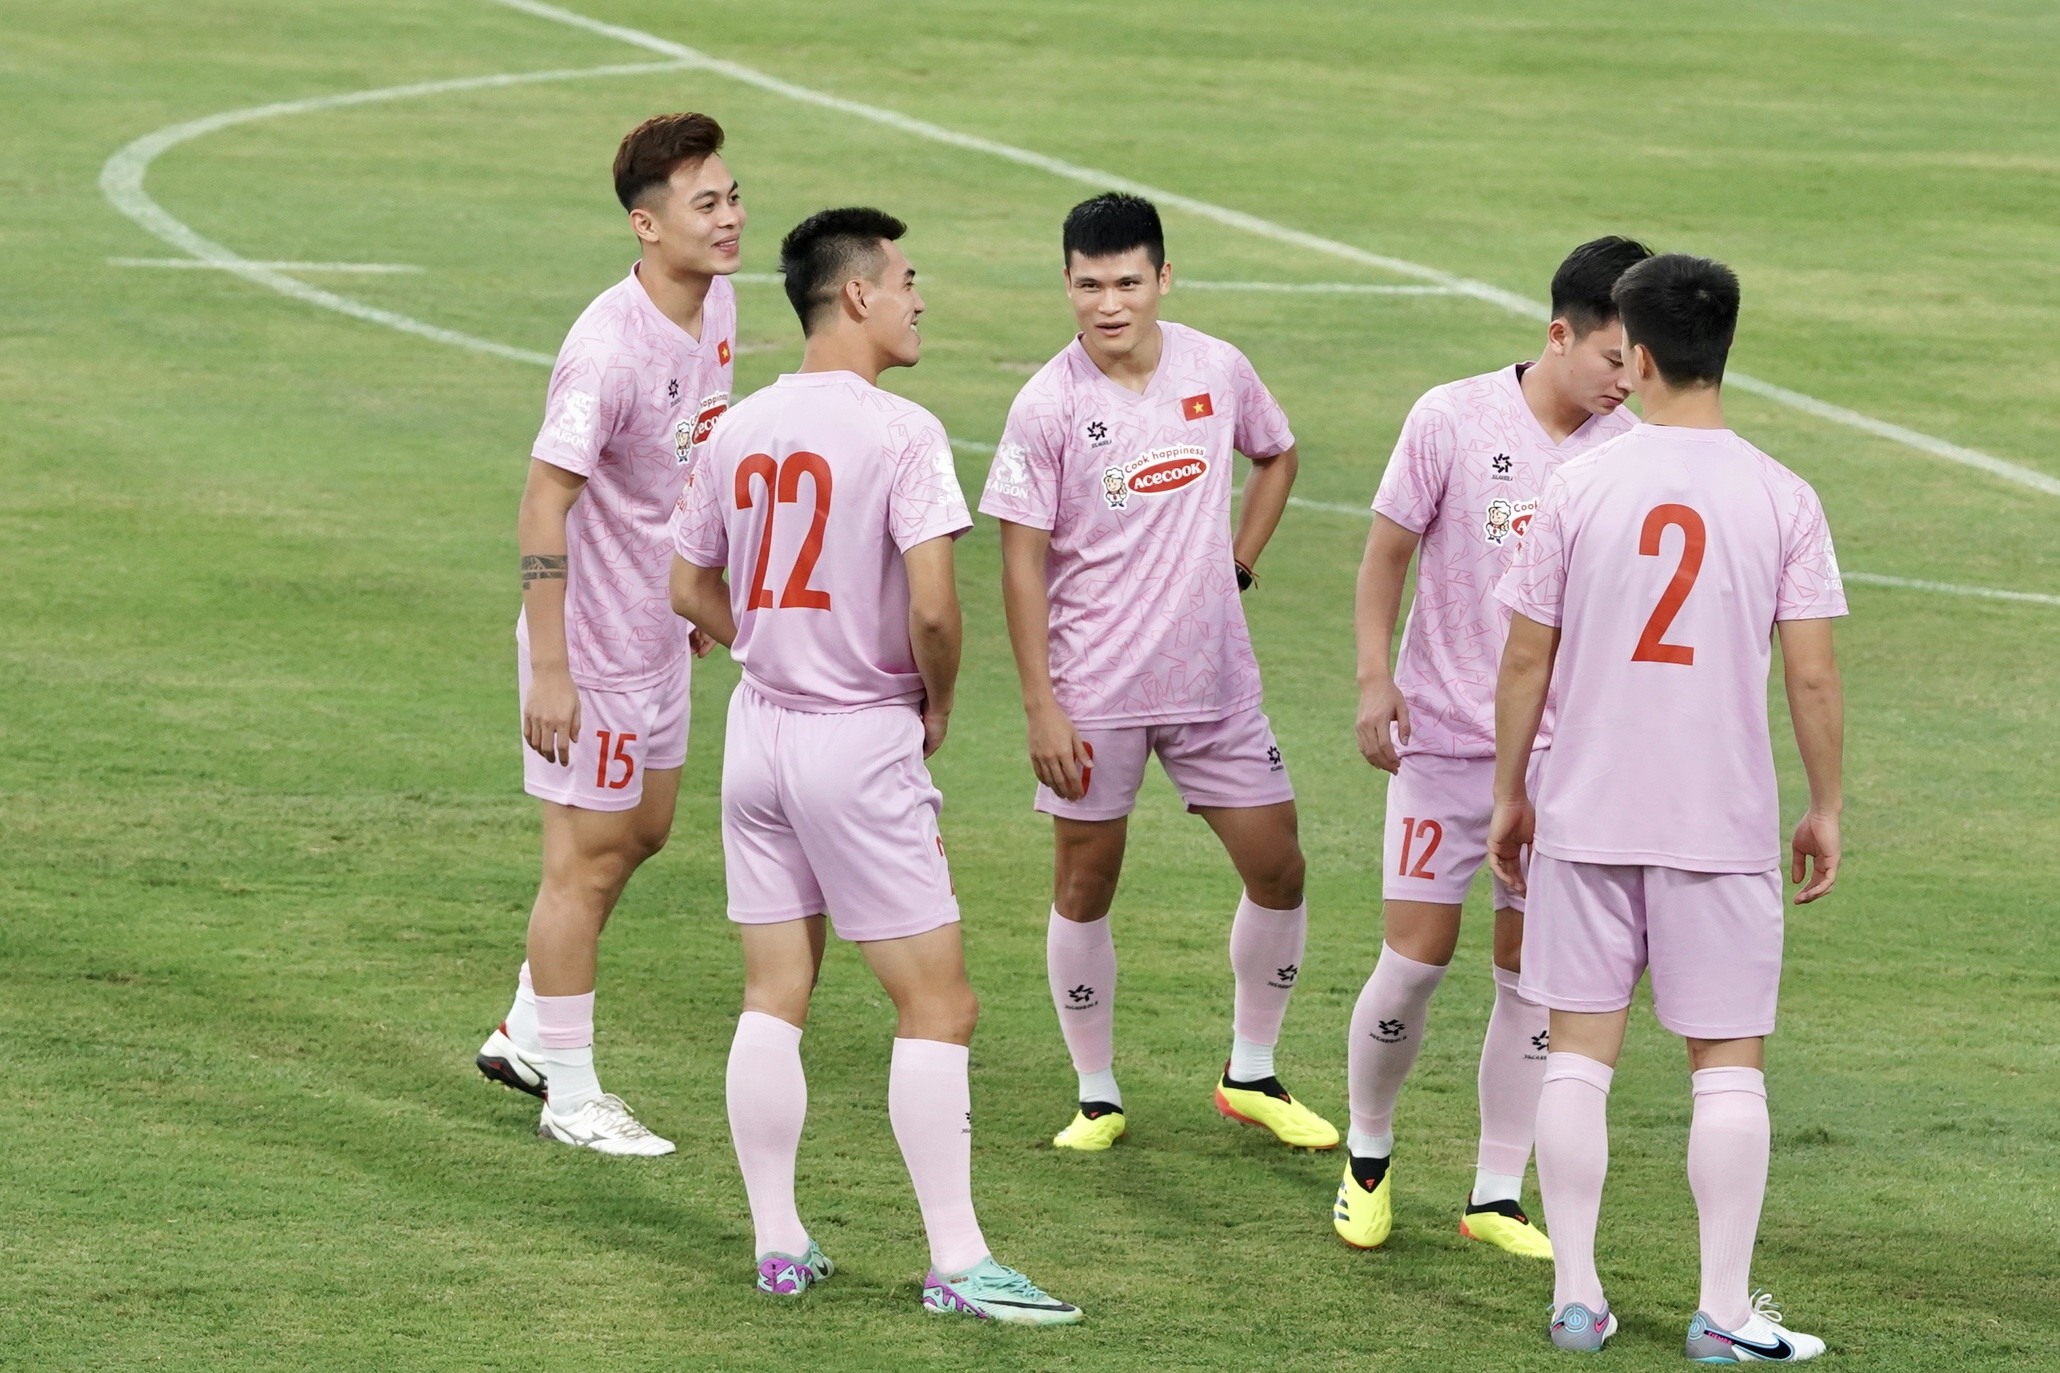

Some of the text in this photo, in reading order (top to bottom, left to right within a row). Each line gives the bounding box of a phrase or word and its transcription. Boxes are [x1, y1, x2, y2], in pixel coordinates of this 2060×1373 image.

[985, 478, 1029, 499] SAIGON
[1125, 446, 1204, 474] Cook happiness
[735, 451, 832, 612] 22
[1631, 503, 1706, 666] 2
[596, 730, 636, 789] 15
[1399, 817, 1443, 880] 12
[1708, 1331, 1733, 1345] TIEMPO
